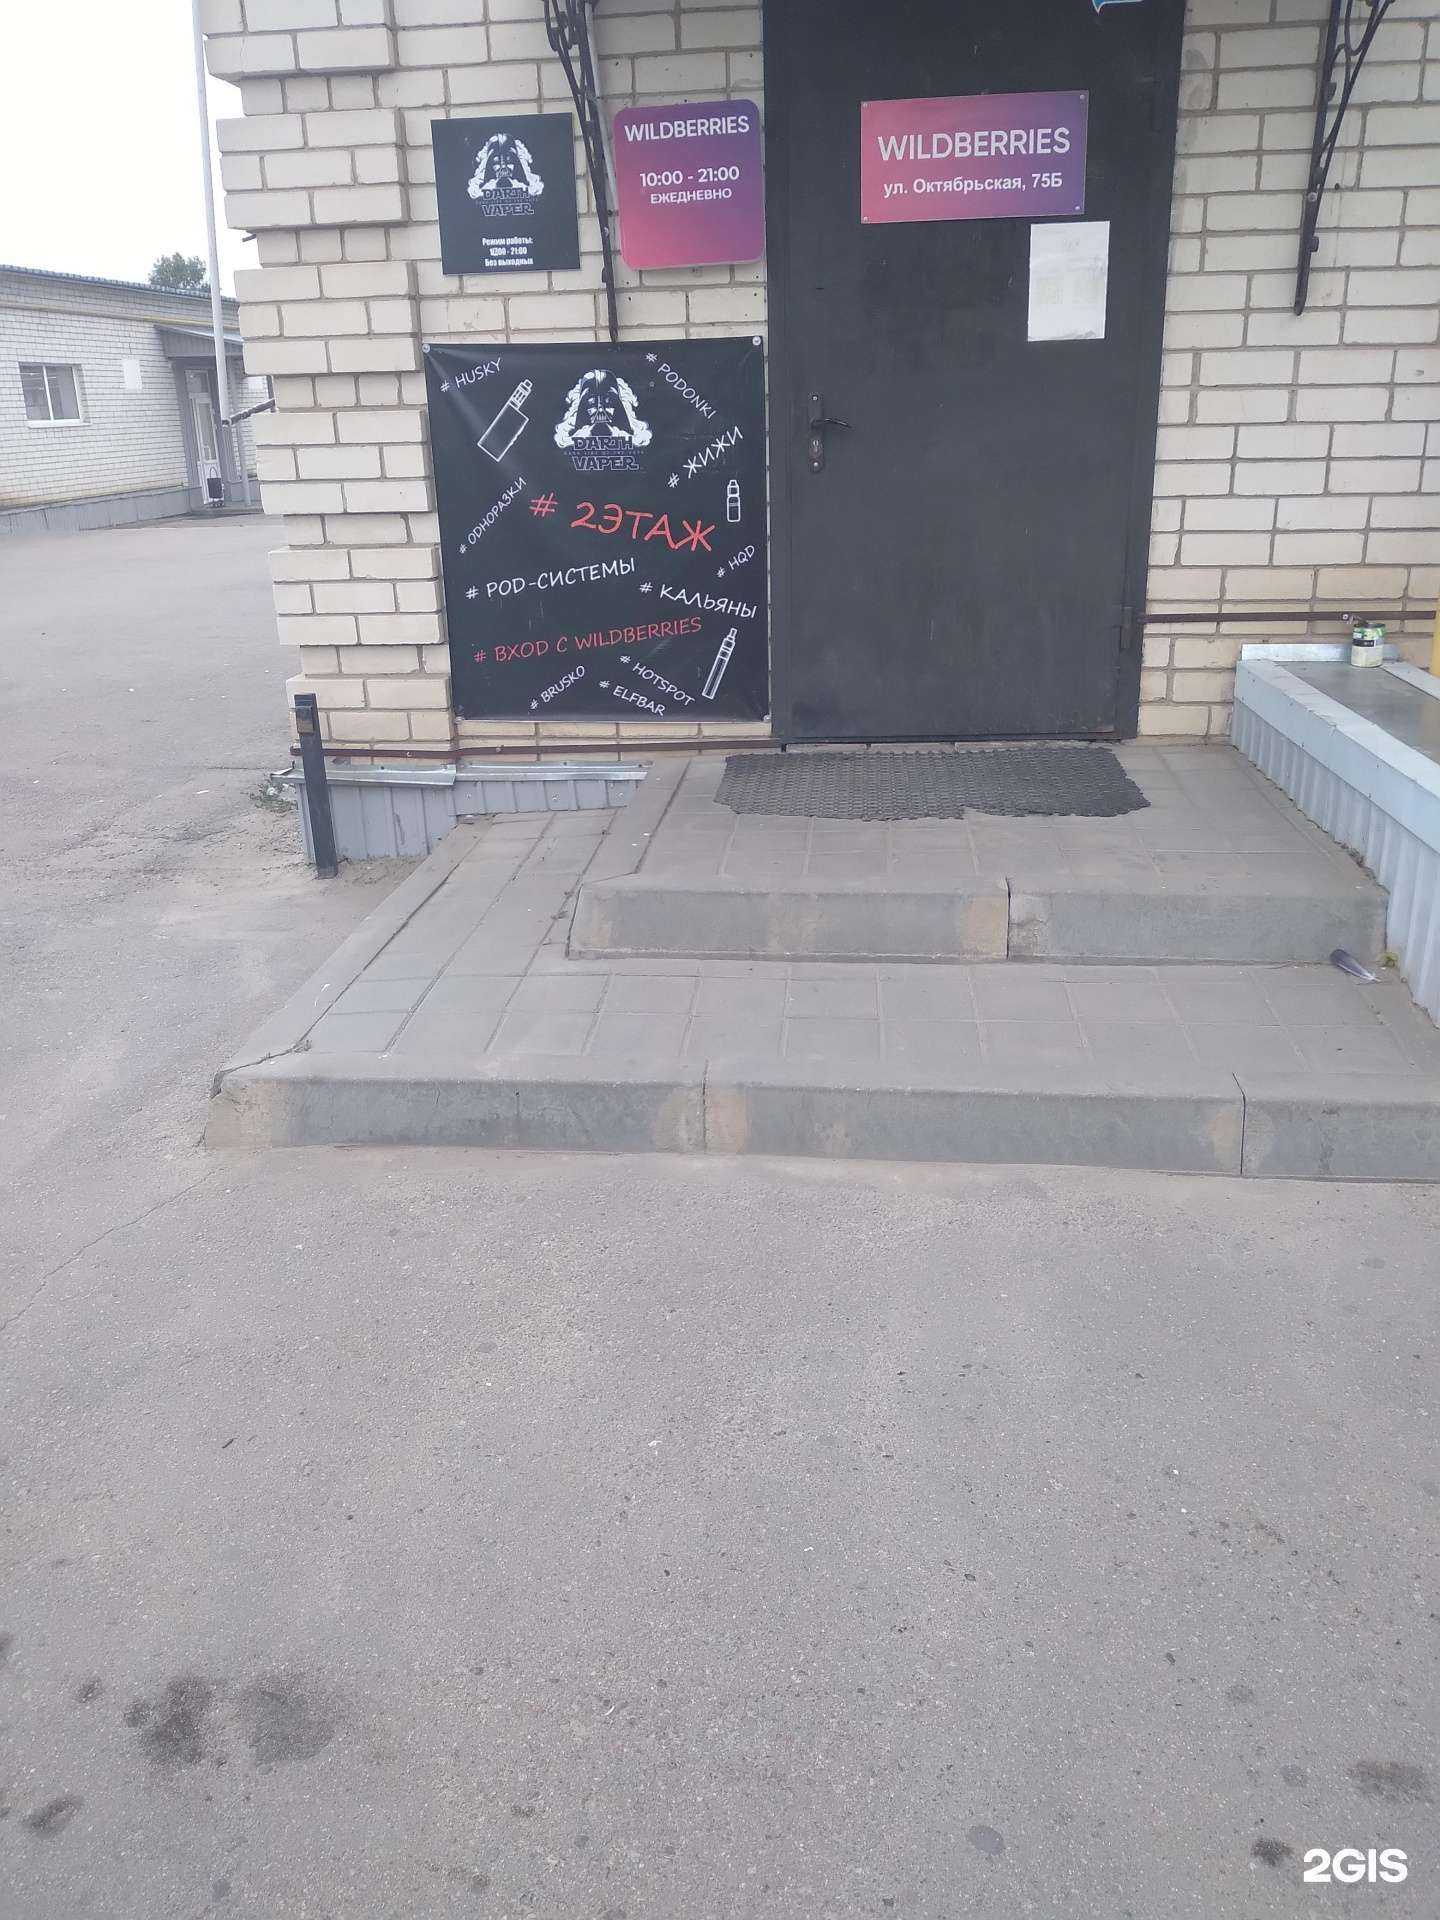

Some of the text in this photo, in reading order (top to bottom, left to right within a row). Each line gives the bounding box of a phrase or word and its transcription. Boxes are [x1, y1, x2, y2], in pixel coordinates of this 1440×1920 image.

[624, 115, 750, 142] WILDBERRIES
[877, 127, 1071, 161] WILDBERRIES
[640, 170, 683, 187] 10:00
[698, 166, 740, 183] 21:00
[883, 172, 1063, 199] ул. Октябрьская, 75Б
[481, 187, 530, 200] DARTH
[650, 188, 732, 205] ЕЖЕДНЕВНО
[481, 203, 534, 216] VAPER
[482, 237, 505, 246] Режим
[485, 258, 497, 267] Без
[455, 357, 502, 388] HUSKY
[658, 363, 717, 419] PODONKI
[572, 436, 634, 450] DARTH
[683, 425, 743, 479] ЖИЖИ
[572, 456, 640, 471] VAPER
[570, 501, 716, 552] 2ЭТАЖ
[728, 545, 755, 570] HQD
[660, 584, 758, 619] КАЛЬЯНЫ
[575, 616, 702, 650] WILDBERRIES
[541, 665, 585, 703] BRUSKO
[632, 662, 695, 706] HOTSPOT
[613, 685, 666, 716] ELFBAR
